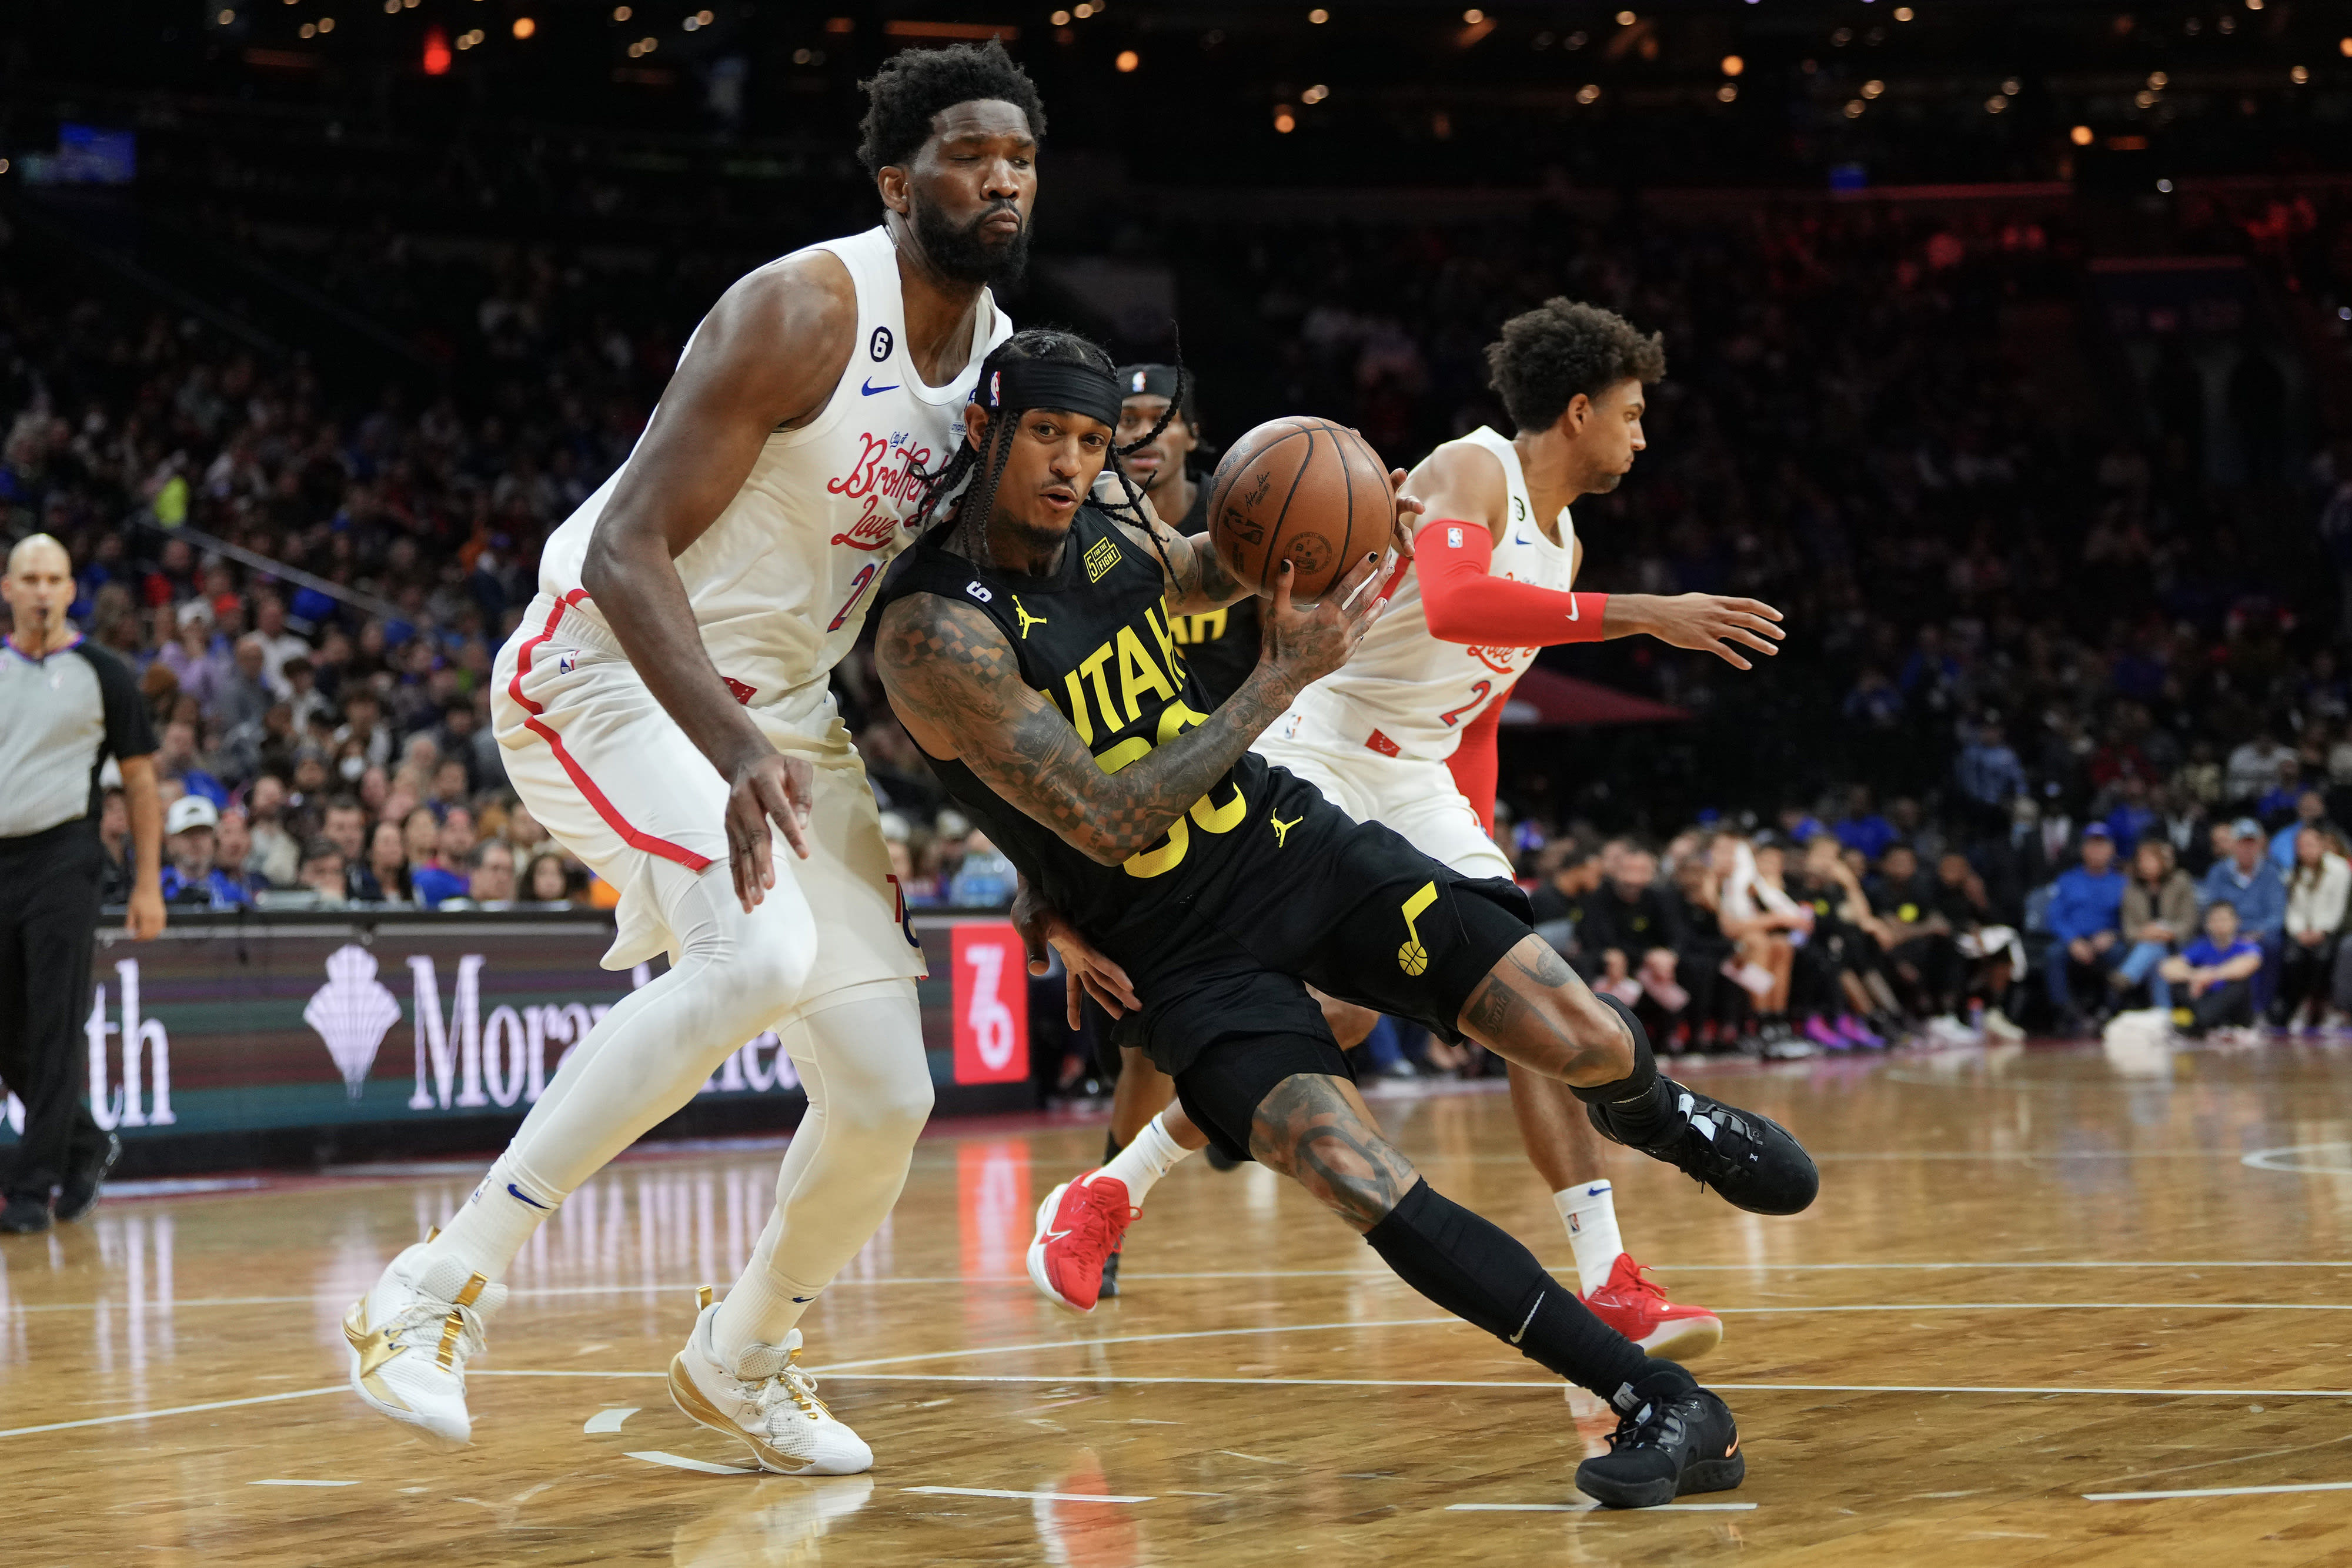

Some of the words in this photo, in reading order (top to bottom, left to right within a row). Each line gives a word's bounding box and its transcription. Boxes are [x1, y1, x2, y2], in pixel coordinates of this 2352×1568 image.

[873, 331, 889, 358] 6
[831, 494, 898, 551] Love
[1086, 555, 1098, 577] 5
[1098, 549, 1117, 571] FIGHT
[966, 581, 992, 603] 6
[965, 944, 1015, 1071] 76
